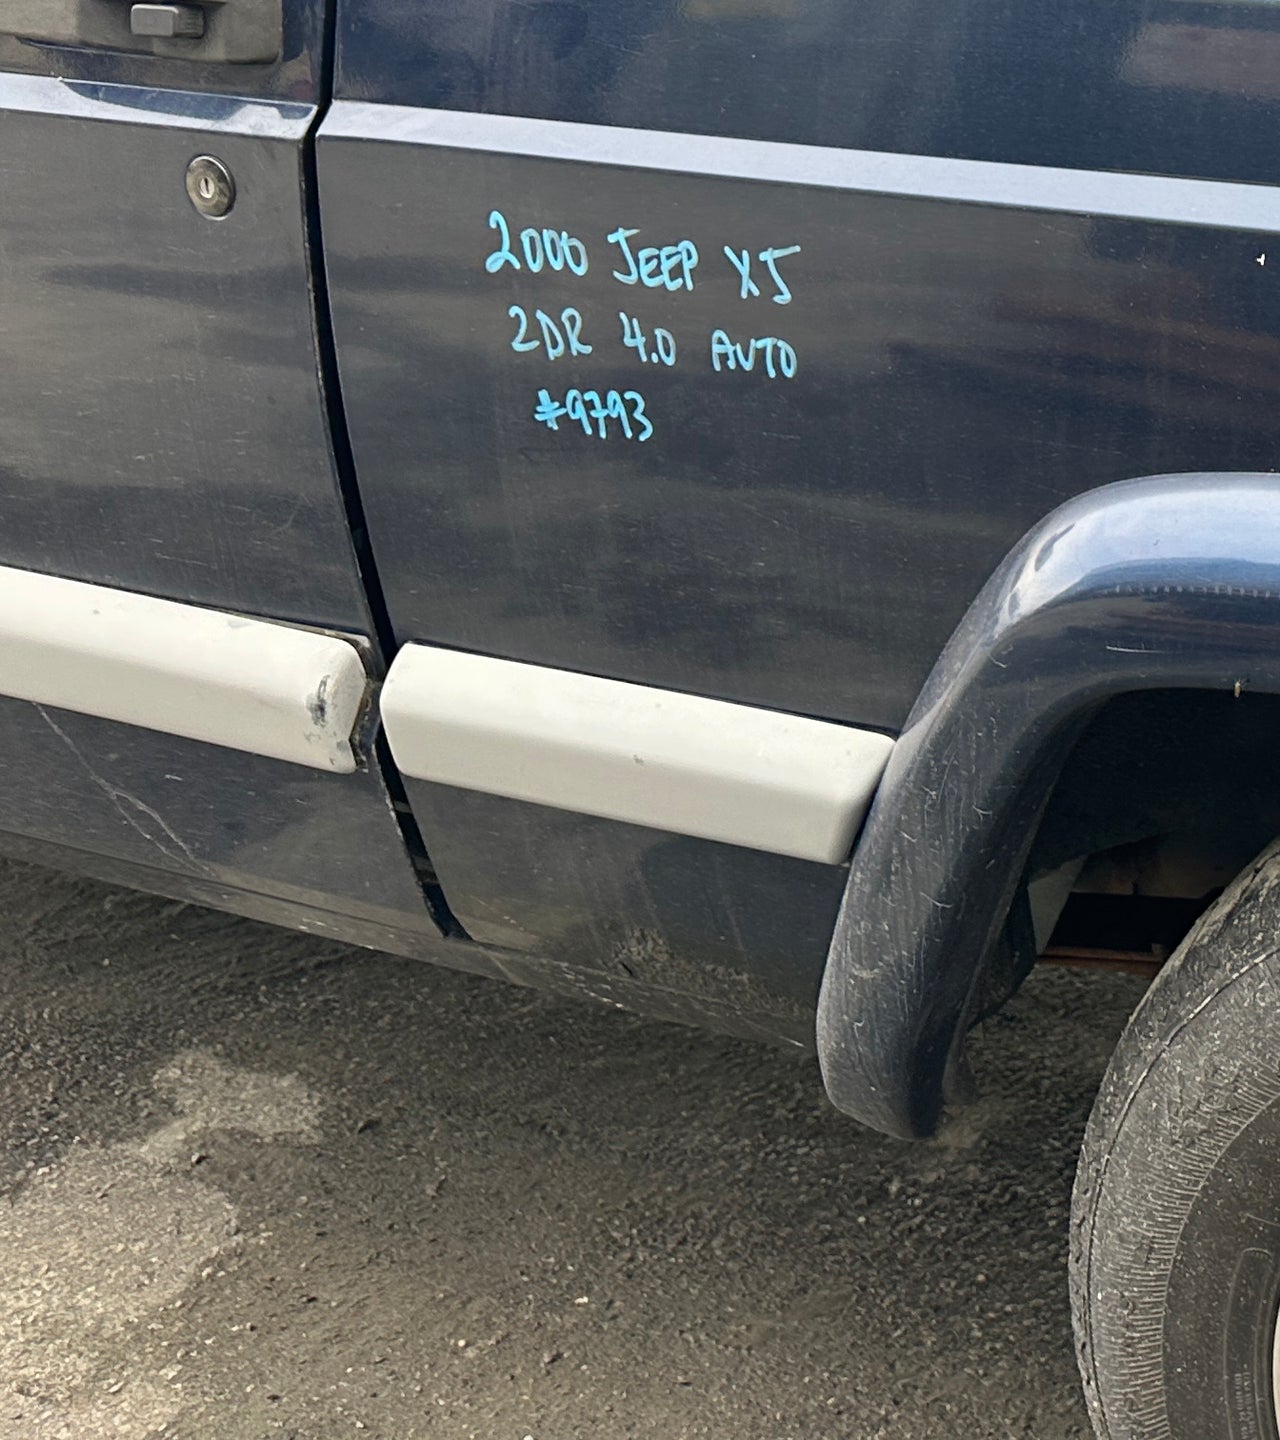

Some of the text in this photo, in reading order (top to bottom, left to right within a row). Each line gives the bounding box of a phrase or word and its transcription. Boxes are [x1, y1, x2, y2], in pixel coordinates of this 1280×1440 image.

[485, 210, 588, 276] 2000
[607, 227, 699, 292] JEEP
[508, 305, 798, 379] 2DR 4.0 AUTO
[534, 388, 654, 442] #9793
